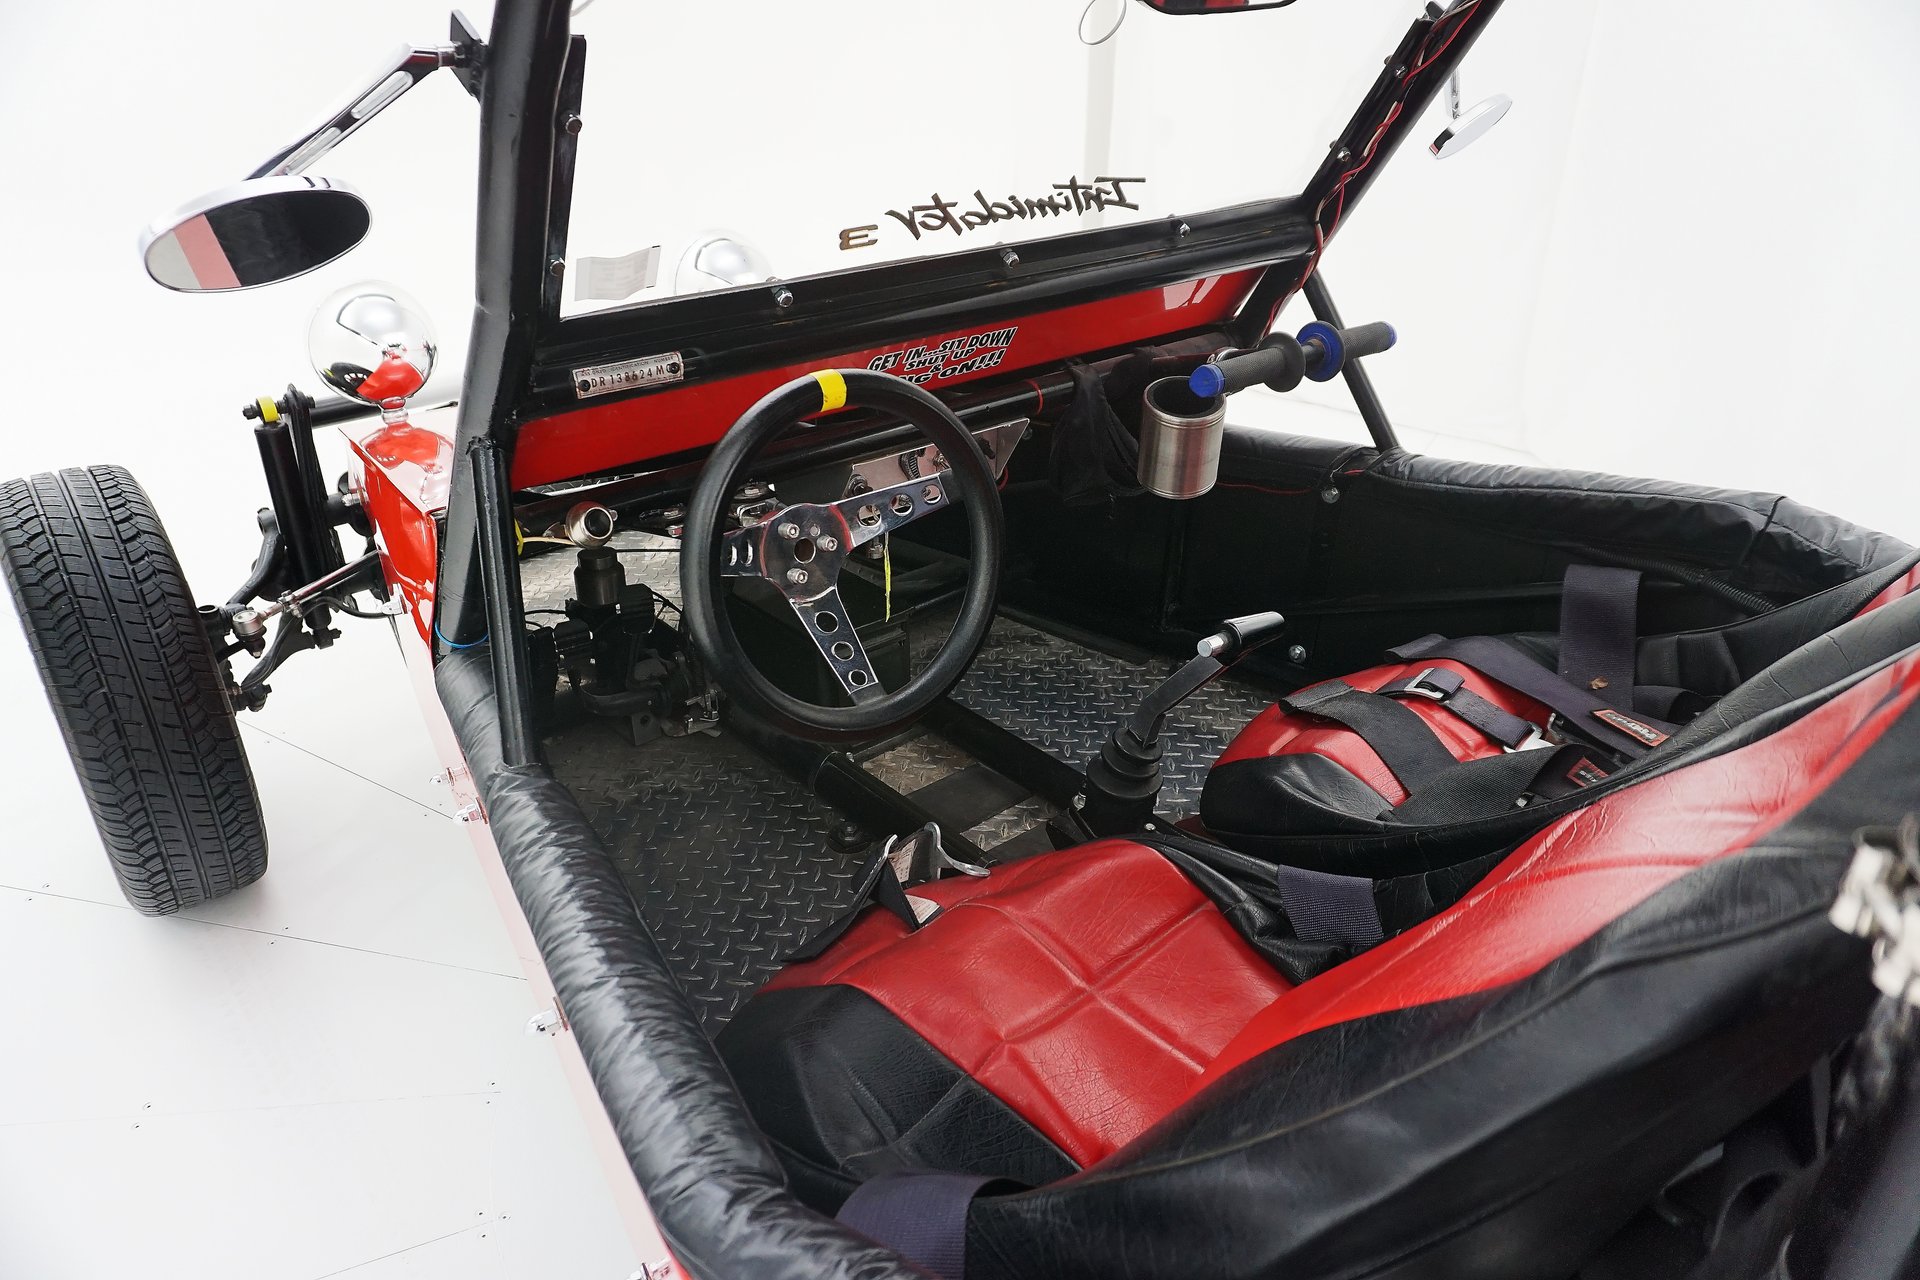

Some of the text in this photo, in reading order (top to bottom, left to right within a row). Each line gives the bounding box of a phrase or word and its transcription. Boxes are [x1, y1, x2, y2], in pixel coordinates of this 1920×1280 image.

[868, 351, 904, 371] GET
[967, 327, 1018, 347] DOWN
[904, 347, 977, 371] SHUT UP
[939, 349, 1006, 378] ON!!!
